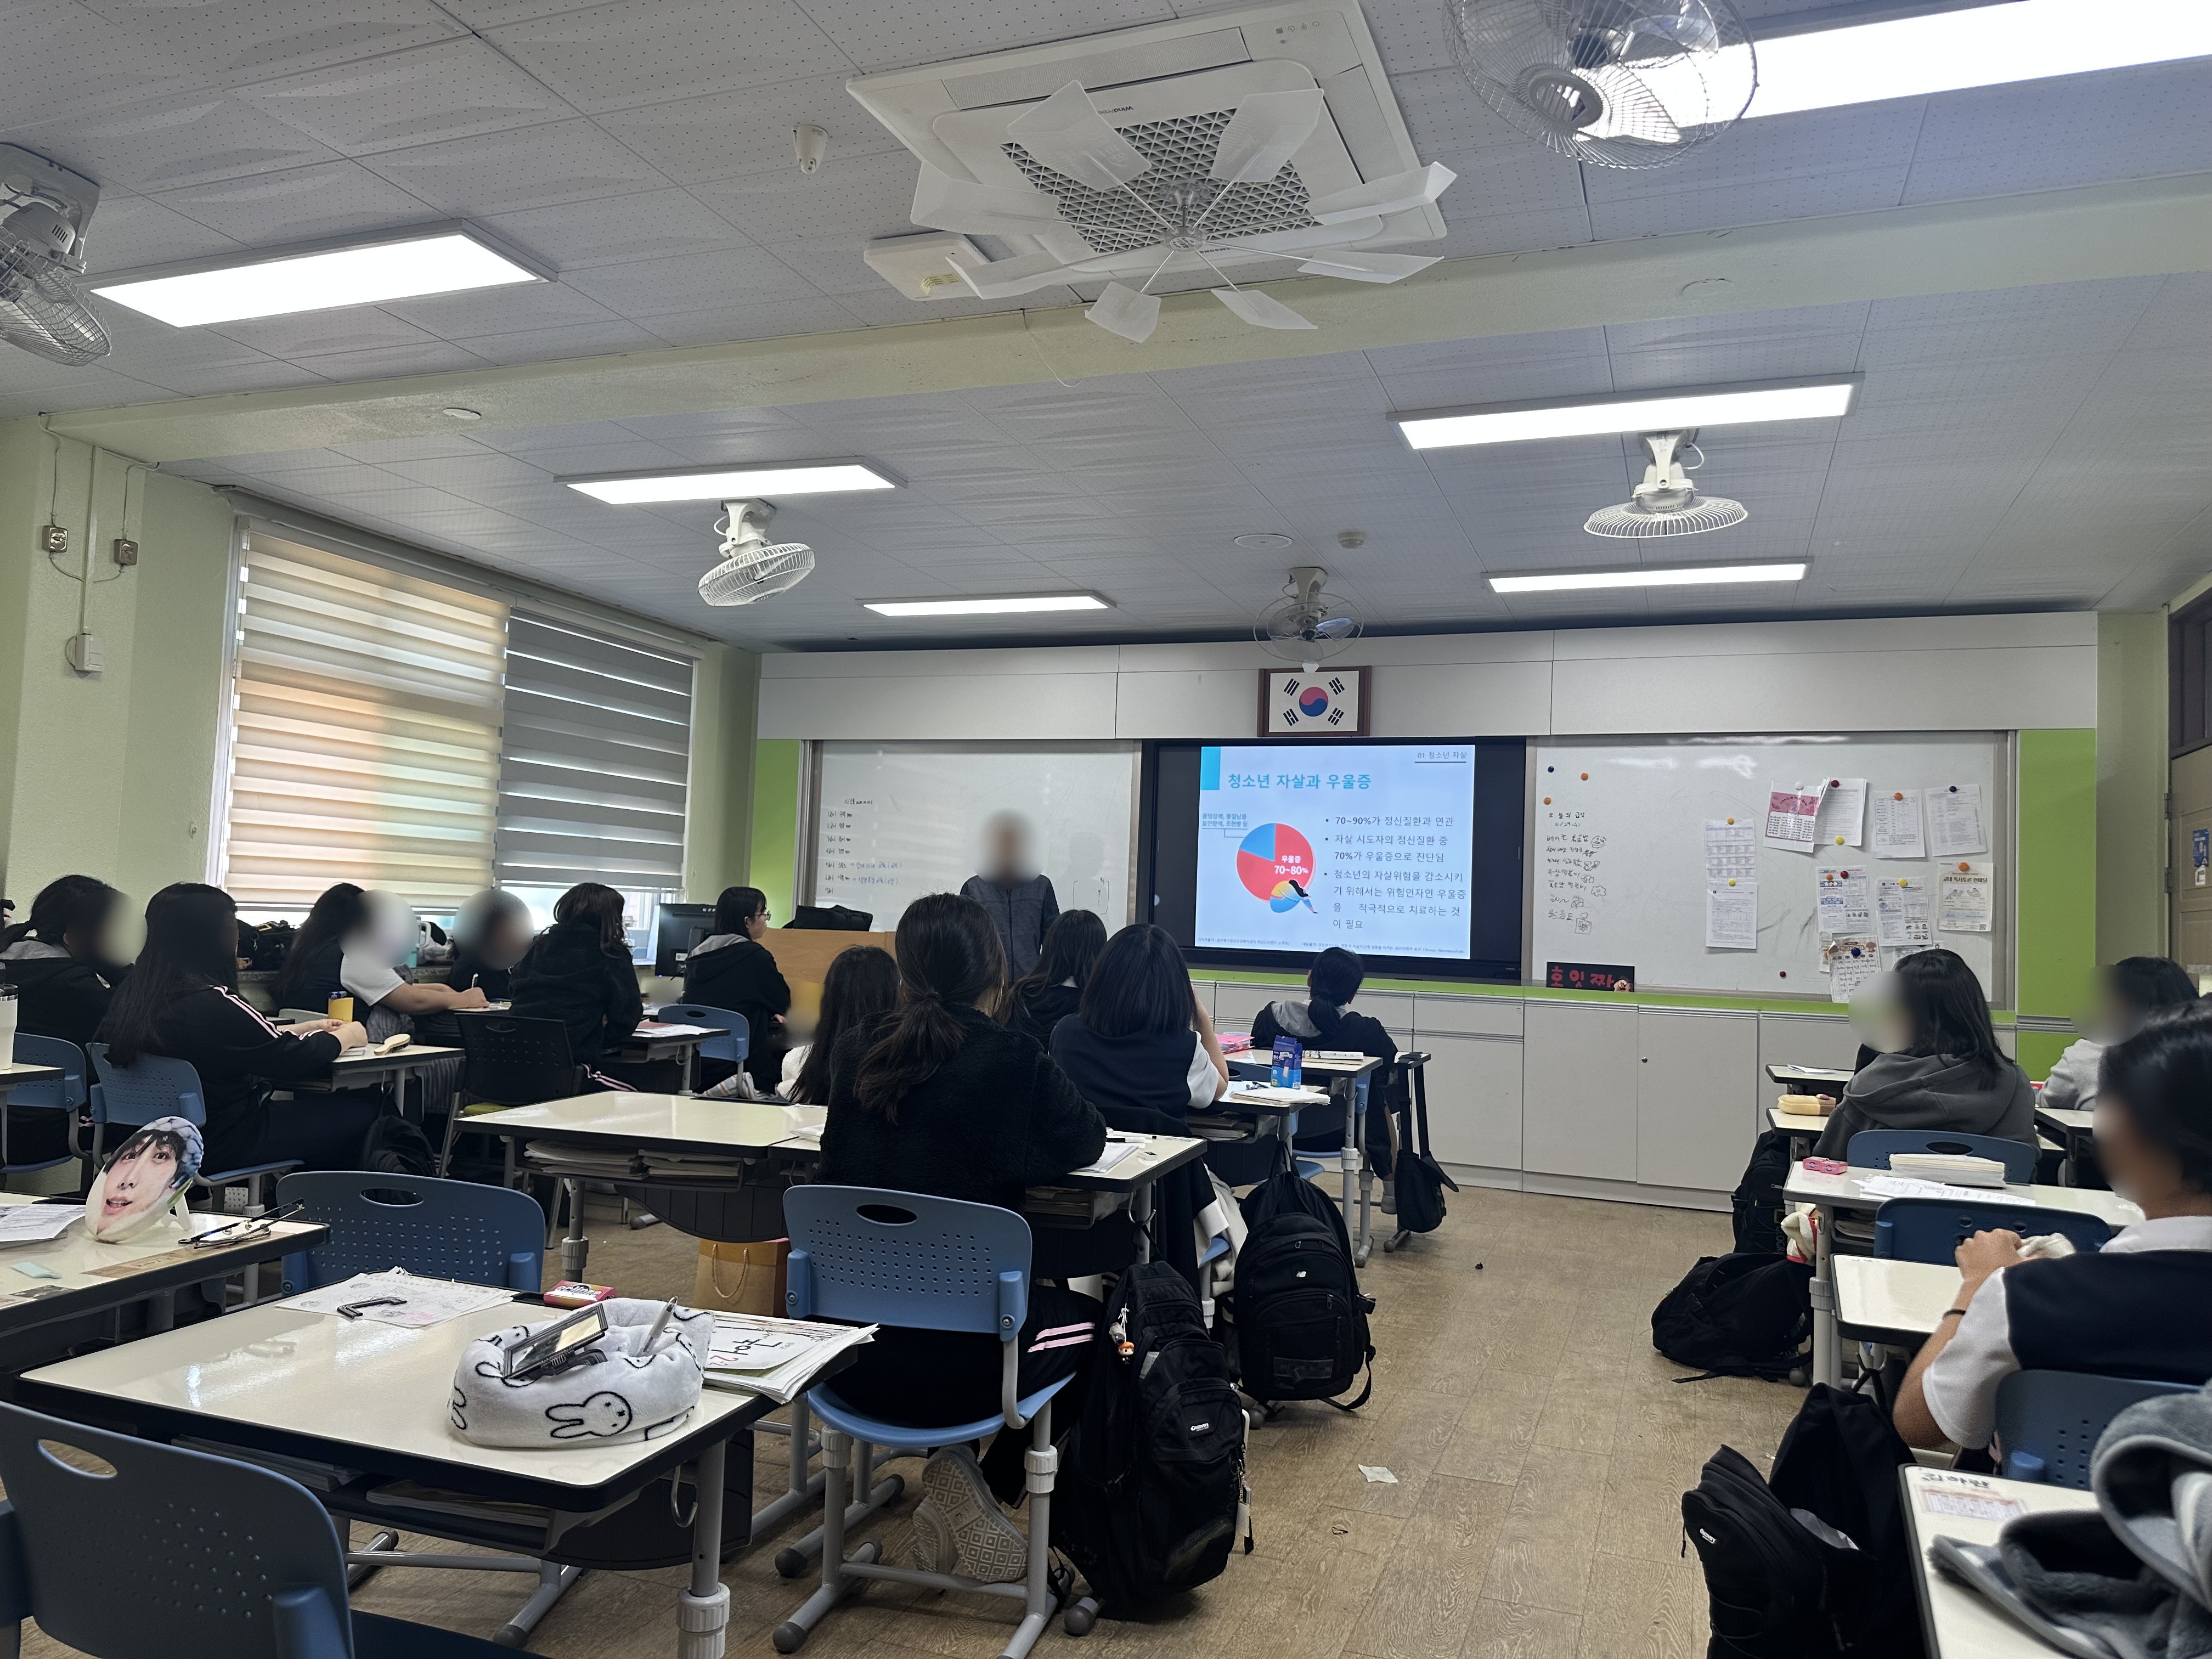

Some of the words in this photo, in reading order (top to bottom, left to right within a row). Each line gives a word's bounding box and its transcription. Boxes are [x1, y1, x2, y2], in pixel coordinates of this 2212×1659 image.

[1452, 751, 1467, 759] 자살
[1228, 774, 1270, 788] 청소년
[1276, 774, 1321, 789] 자살과
[1327, 774, 1372, 789] 우울증
[1335, 816, 1380, 826] 70~90%가
[1384, 816, 1431, 826] 정신질환과
[1435, 817, 1453, 827] 연관
[1335, 834, 1352, 844] 자살
[1357, 835, 1393, 845] 시도자의
[1397, 836, 1435, 845] 정신질환
[1438, 836, 1448, 845] 중
[1335, 851, 1362, 861] 70%가
[1365, 852, 1412, 861] 우울증으로
[1416, 853, 1444, 862] 진단됨
[1274, 865, 1308, 874] 70~80%
[1334, 870, 1370, 879] 청소년의
[1374, 871, 1421, 881] 자살위험을
[1425, 872, 1463, 882] 감소시키
[1334, 887, 1342, 896] 기
[1346, 887, 1383, 896] 위해서는
[1386, 887, 1433, 899] 위험인자인
[1437, 889, 1466, 900] 우울증
[1333, 903, 1342, 912] 을
[1358, 904, 1405, 913] 적극적으로
[1409, 905, 1447, 916] 치료하는
[1451, 907, 1460, 917] 것
[1333, 919, 1341, 929] 이
[1345, 919, 1363, 929] 필요
[1551, 966, 1615, 988] 호잇짜
